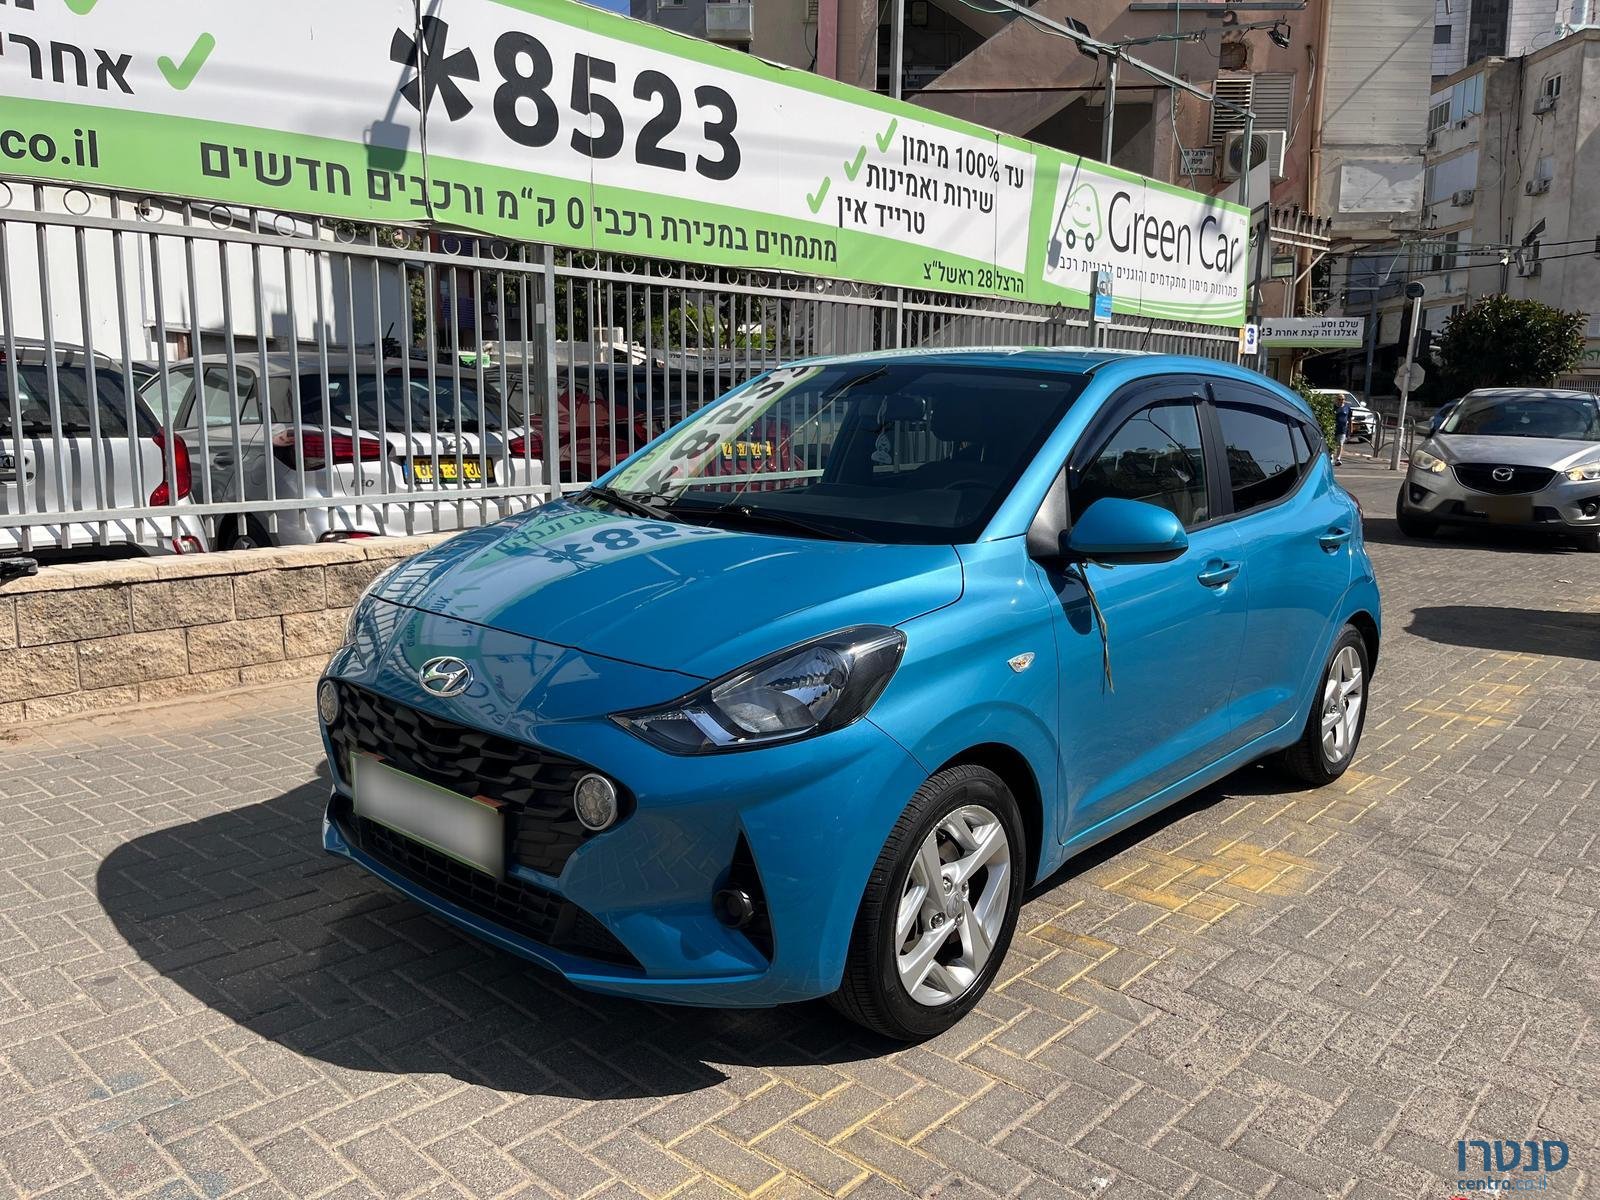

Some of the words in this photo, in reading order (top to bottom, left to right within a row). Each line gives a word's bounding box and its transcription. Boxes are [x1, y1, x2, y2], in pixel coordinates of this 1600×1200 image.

[902, 135, 949, 169] מימון
[955, 147, 1000, 183] 100%
[200, 142, 351, 196] חדשים
[866, 163, 938, 202] ואמינות
[1004, 165, 1024, 189] עד
[366, 168, 484, 215] ורכבים
[943, 182, 993, 214] שירות
[593, 206, 652, 239] רכבי
[837, 196, 868, 229] אין
[874, 203, 925, 234] טרייד
[661, 216, 749, 251] במכירת
[756, 229, 837, 263] מתמחים
[1108, 191, 1191, 264] Green
[1199, 215, 1239, 273] Car
[977, 268, 993, 288] 28
[1059, 256, 1078, 271] רכב
[996, 270, 1024, 294] הרצל
[1275, 329, 1299, 337] אחרת
[1300, 329, 1319, 339] קצת
[1321, 329, 1332, 337] זה
[1333, 328, 1358, 337] אצלנו
[1338, 319, 1359, 328] שלם
